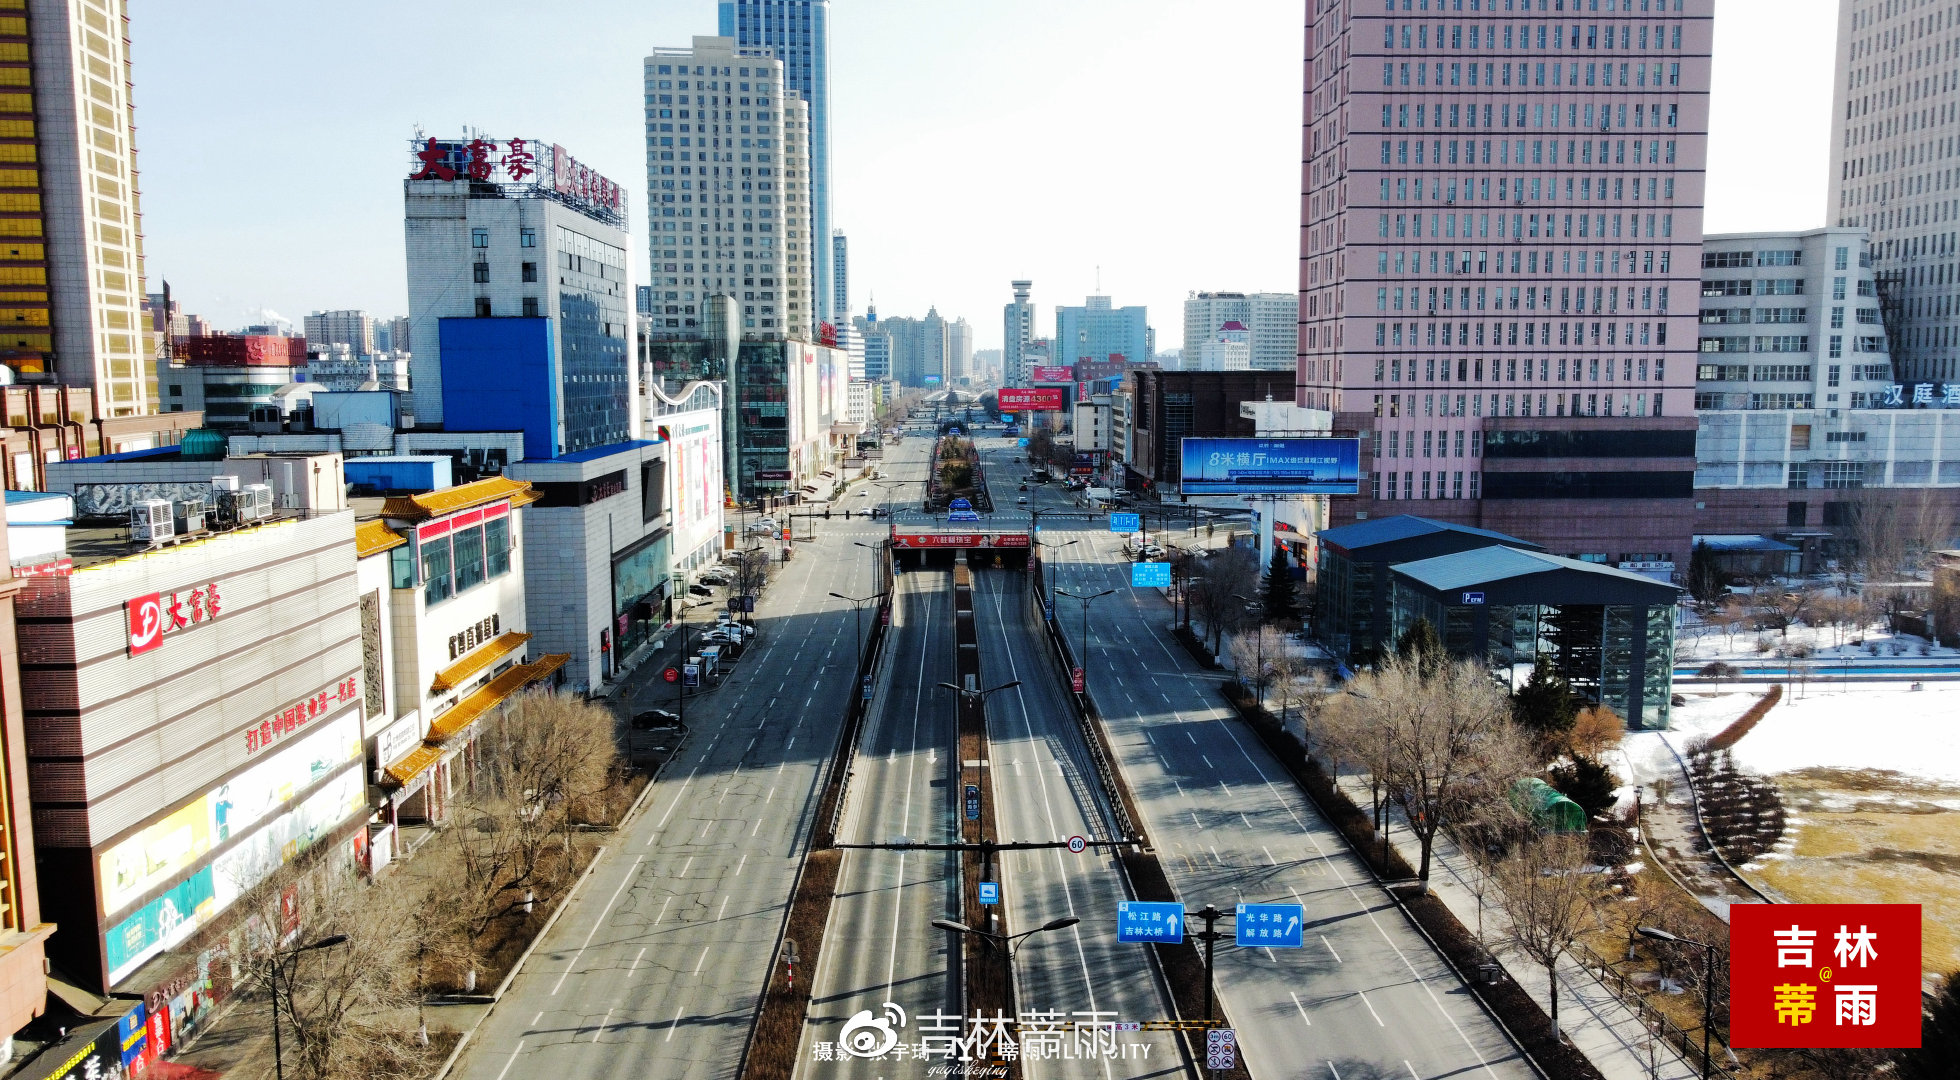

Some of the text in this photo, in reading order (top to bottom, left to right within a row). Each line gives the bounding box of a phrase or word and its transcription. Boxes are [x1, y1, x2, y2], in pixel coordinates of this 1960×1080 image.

[409, 137, 534, 181] 大富豪
[1884, 383, 1960, 404] 汉庭酒
[164, 583, 222, 633] 大富豪
[246, 676, 357, 756] 打造中国鞋业第一名店
[1071, 840, 1083, 849] 60
[1127, 911, 1162, 922] 松江路
[1245, 912, 1283, 923] 光华路
[1125, 927, 1164, 937] 吉林大桥
[1245, 928, 1283, 939] 解放路
